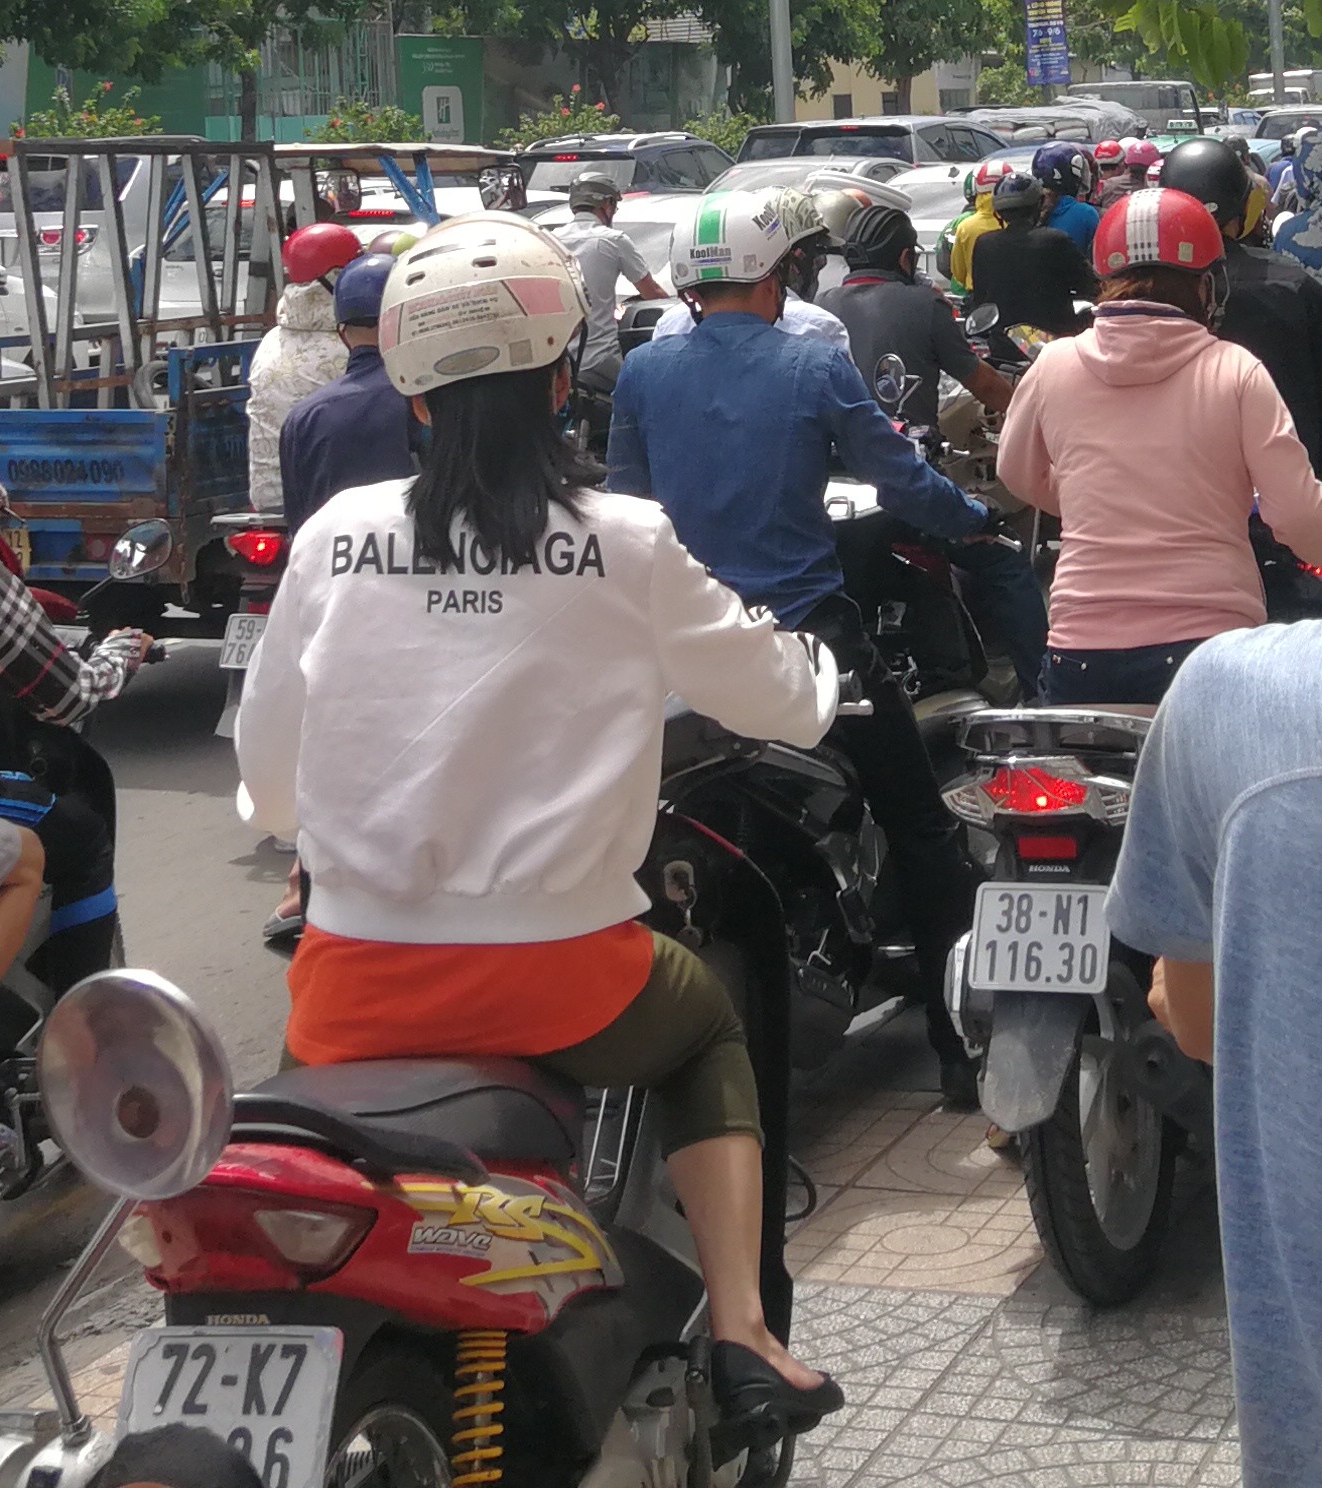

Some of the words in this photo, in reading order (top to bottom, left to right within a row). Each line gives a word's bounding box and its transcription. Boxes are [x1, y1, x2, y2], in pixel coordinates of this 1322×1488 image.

[426, 590, 503, 614] PARIS
[1029, 865, 1070, 873] HONDA
[996, 893, 1089, 937] 38-N1
[985, 940, 1098, 985] 116.30
[207, 1314, 270, 1325] HONDA
[153, 1343, 308, 1416] 72-K7
